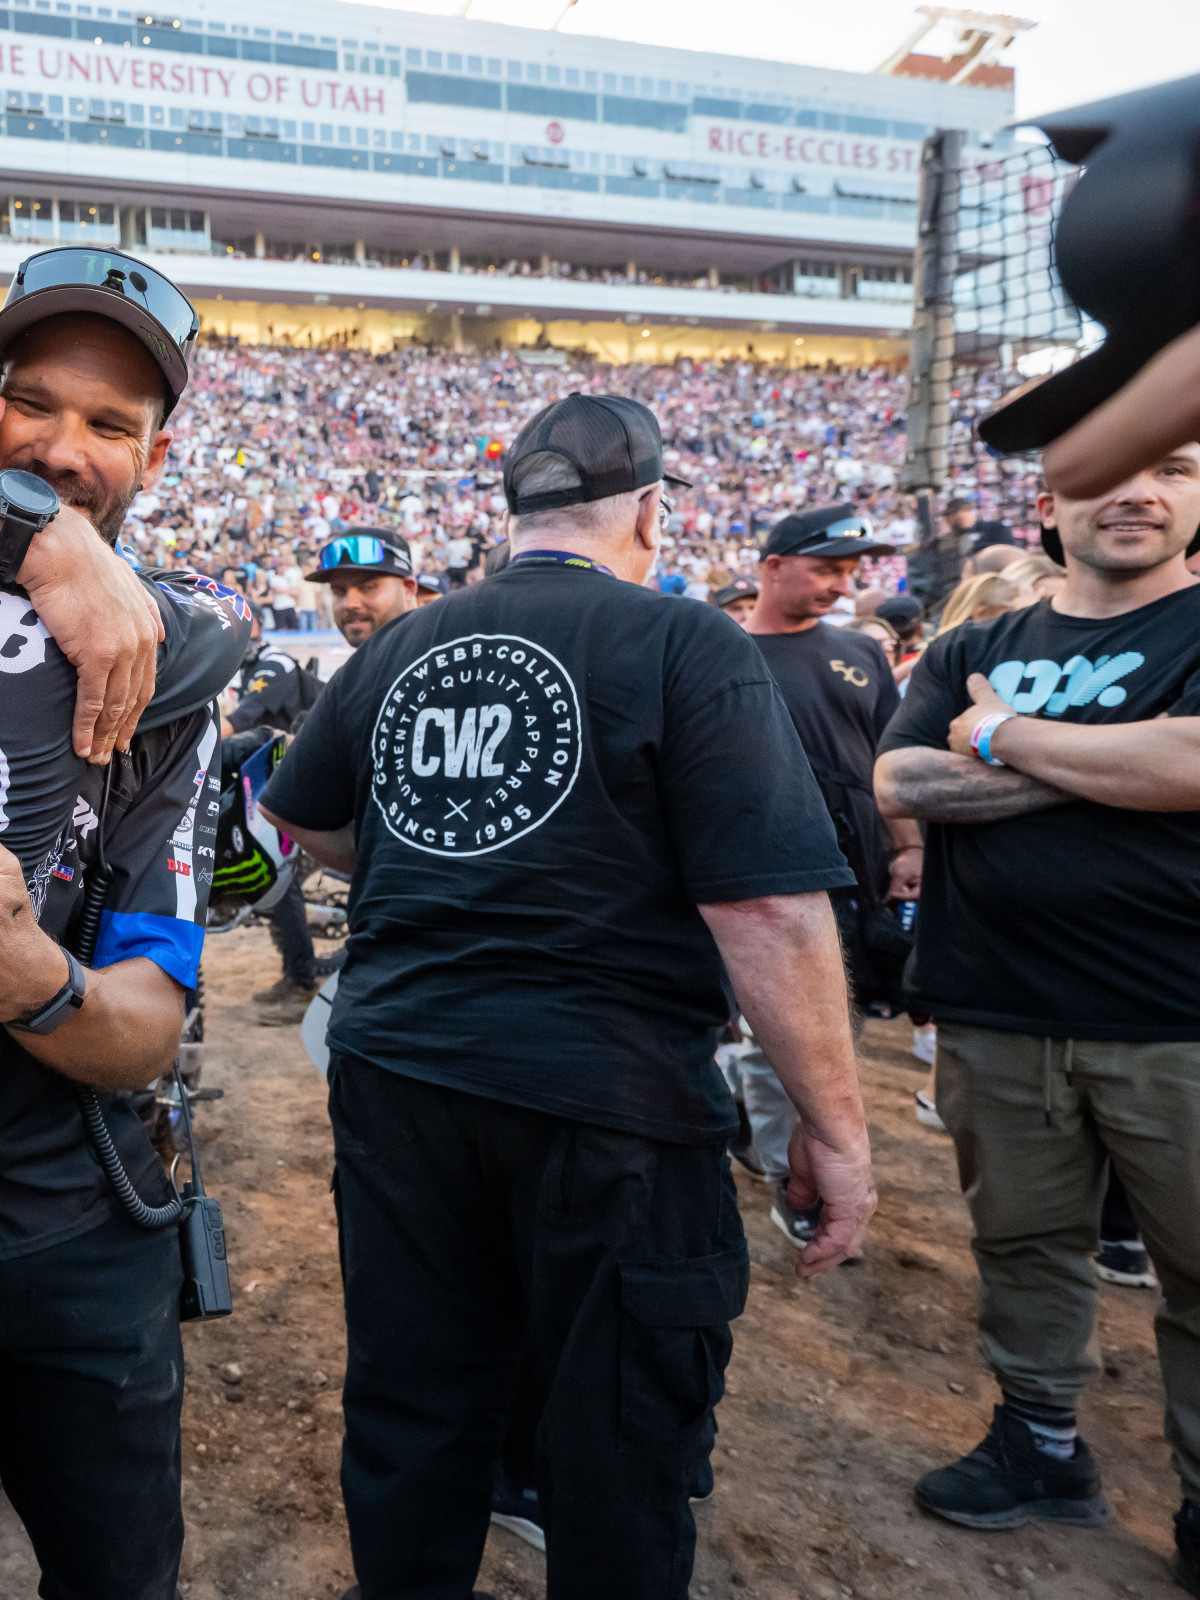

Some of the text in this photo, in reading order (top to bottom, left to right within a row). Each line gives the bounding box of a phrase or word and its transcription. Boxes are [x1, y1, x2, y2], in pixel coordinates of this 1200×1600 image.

[39, 48, 236, 98] UNIVERSITY
[247, 72, 289, 104] OF
[301, 78, 385, 115] UTAH
[708, 127, 880, 172] RICE-ECCLES
[393, 669, 540, 809] AUTHENTIC QUALITY APPAREL
[412, 704, 512, 778] CW2
[413, 643, 482, 680] WEBB
[496, 645, 572, 787] COLLECTION
[389, 801, 532, 847] SINCE 1995
